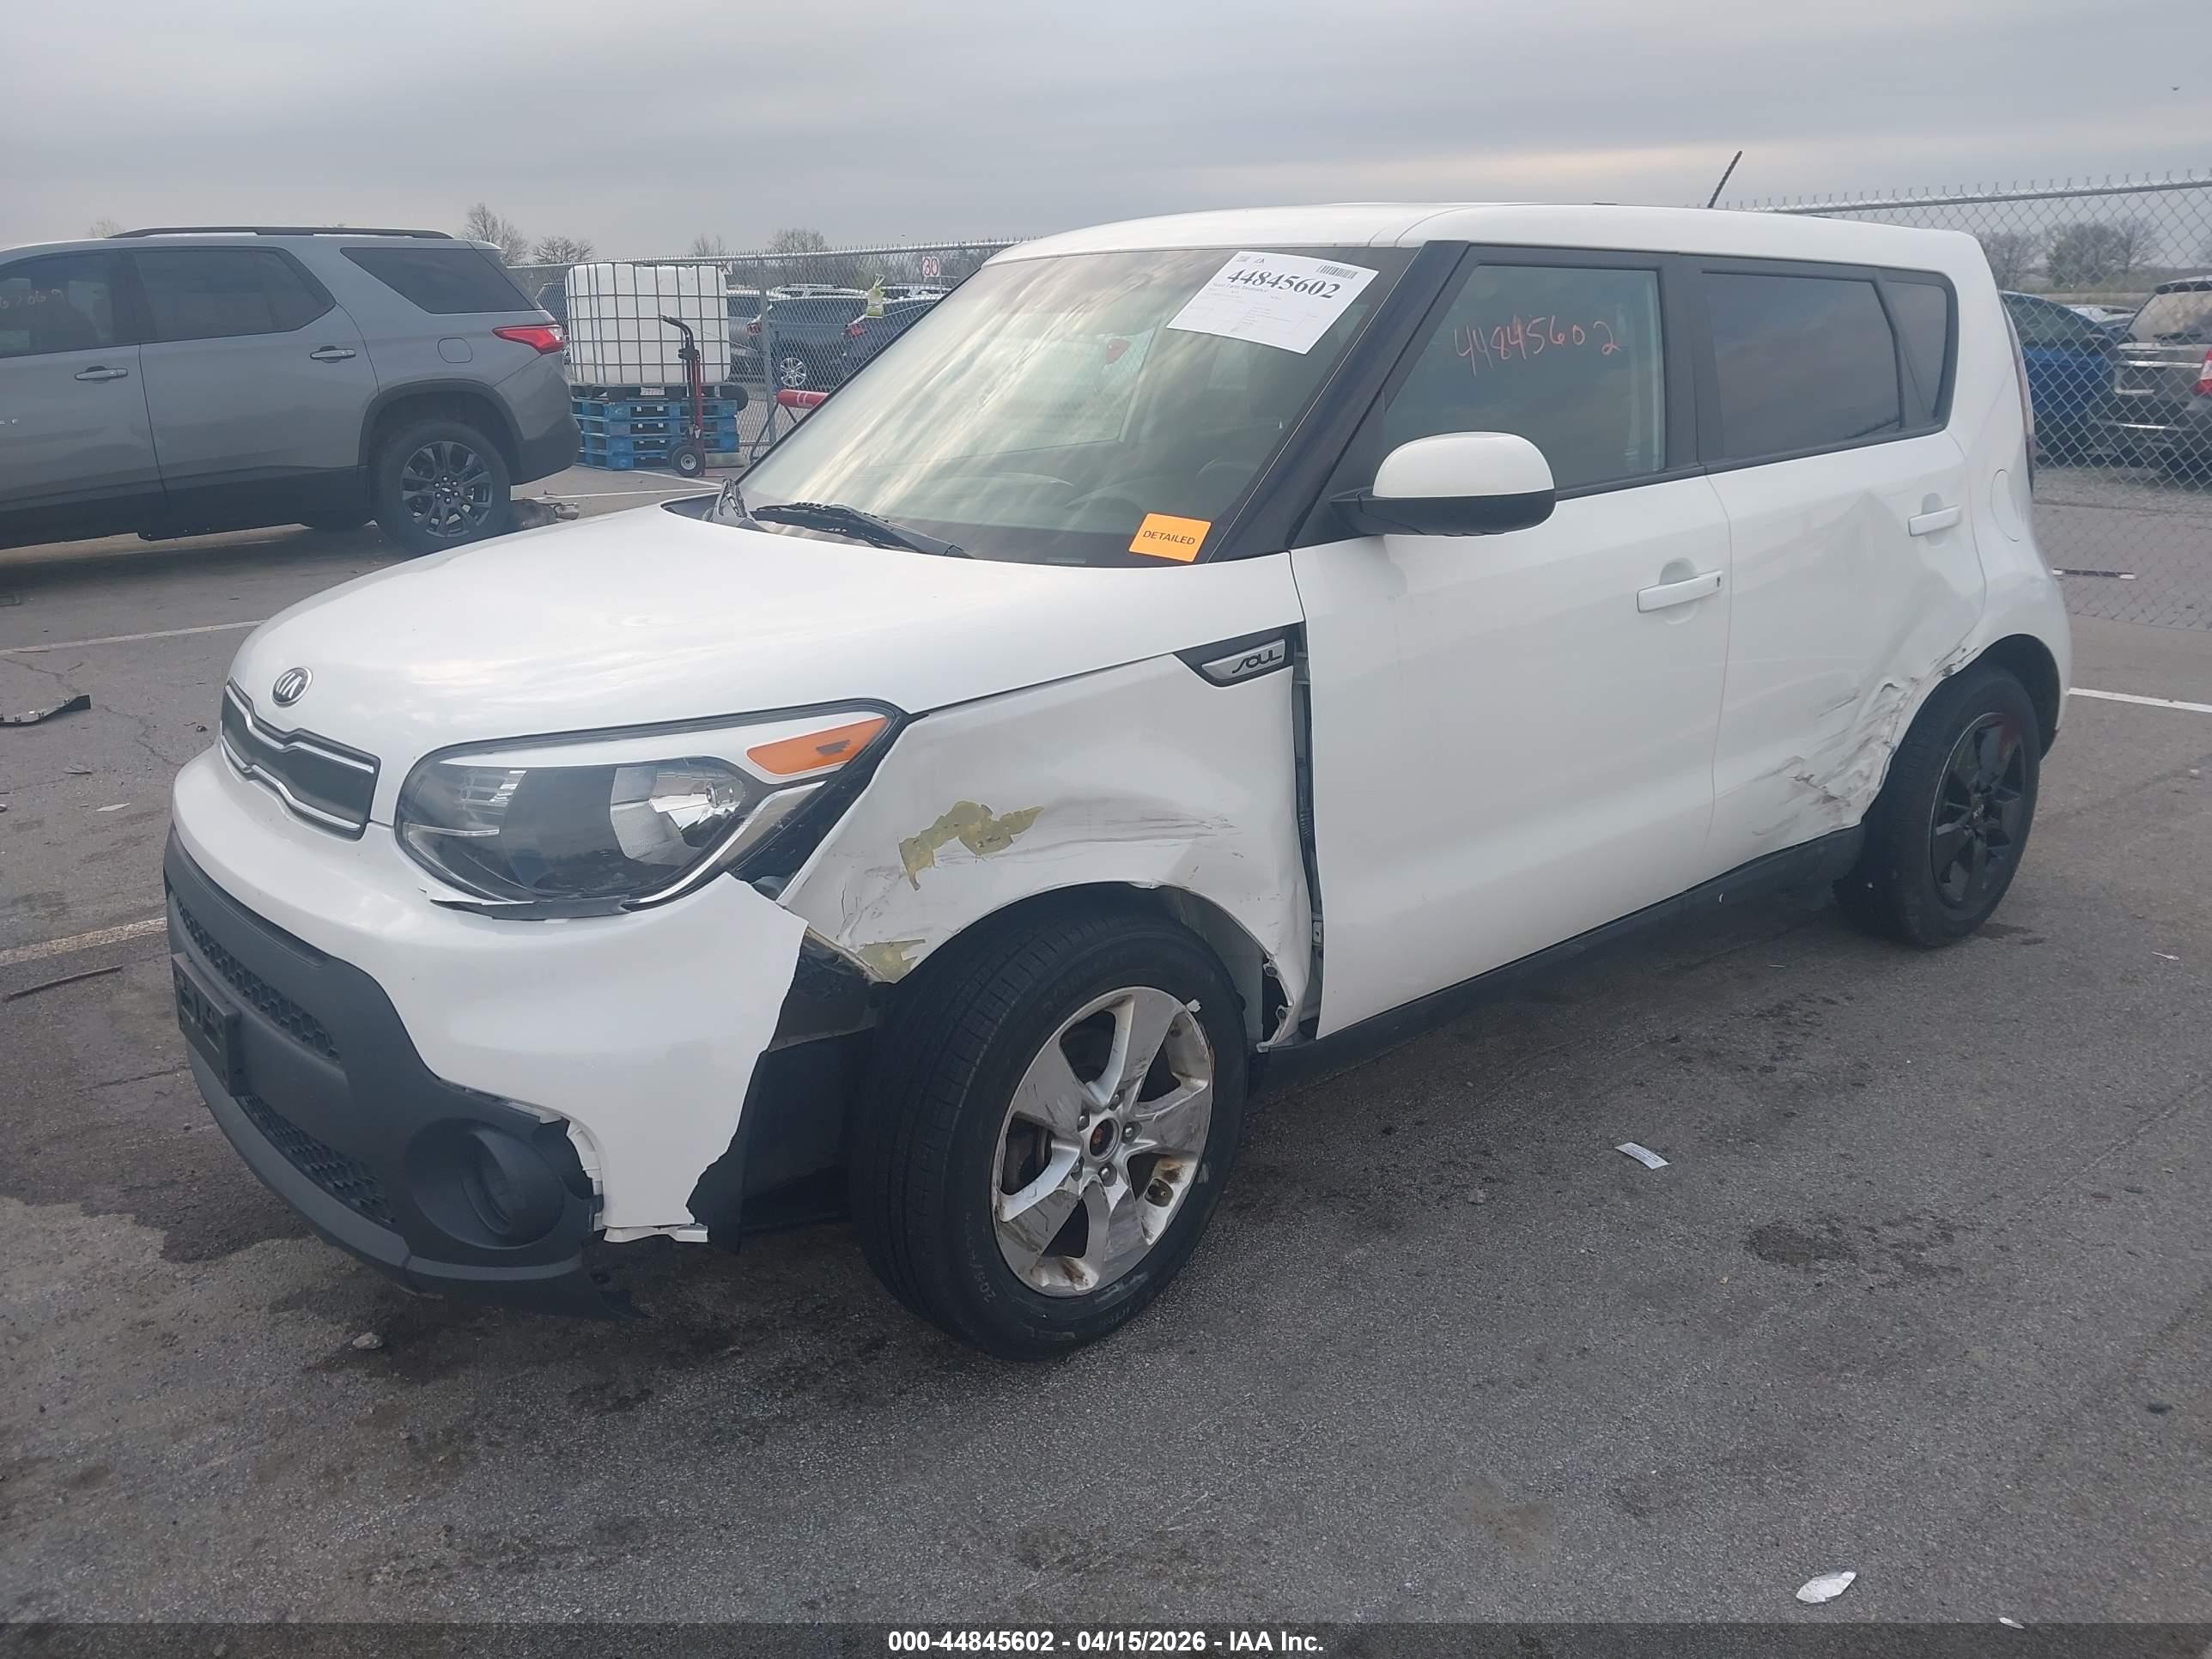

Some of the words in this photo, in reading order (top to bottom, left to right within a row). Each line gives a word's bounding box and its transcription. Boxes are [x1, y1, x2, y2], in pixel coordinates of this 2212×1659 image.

[924, 258, 938, 276] 30
[1227, 269, 1341, 298] 44845602
[1454, 315, 1621, 376] 44845602
[1142, 530, 1195, 545] DETAILED
